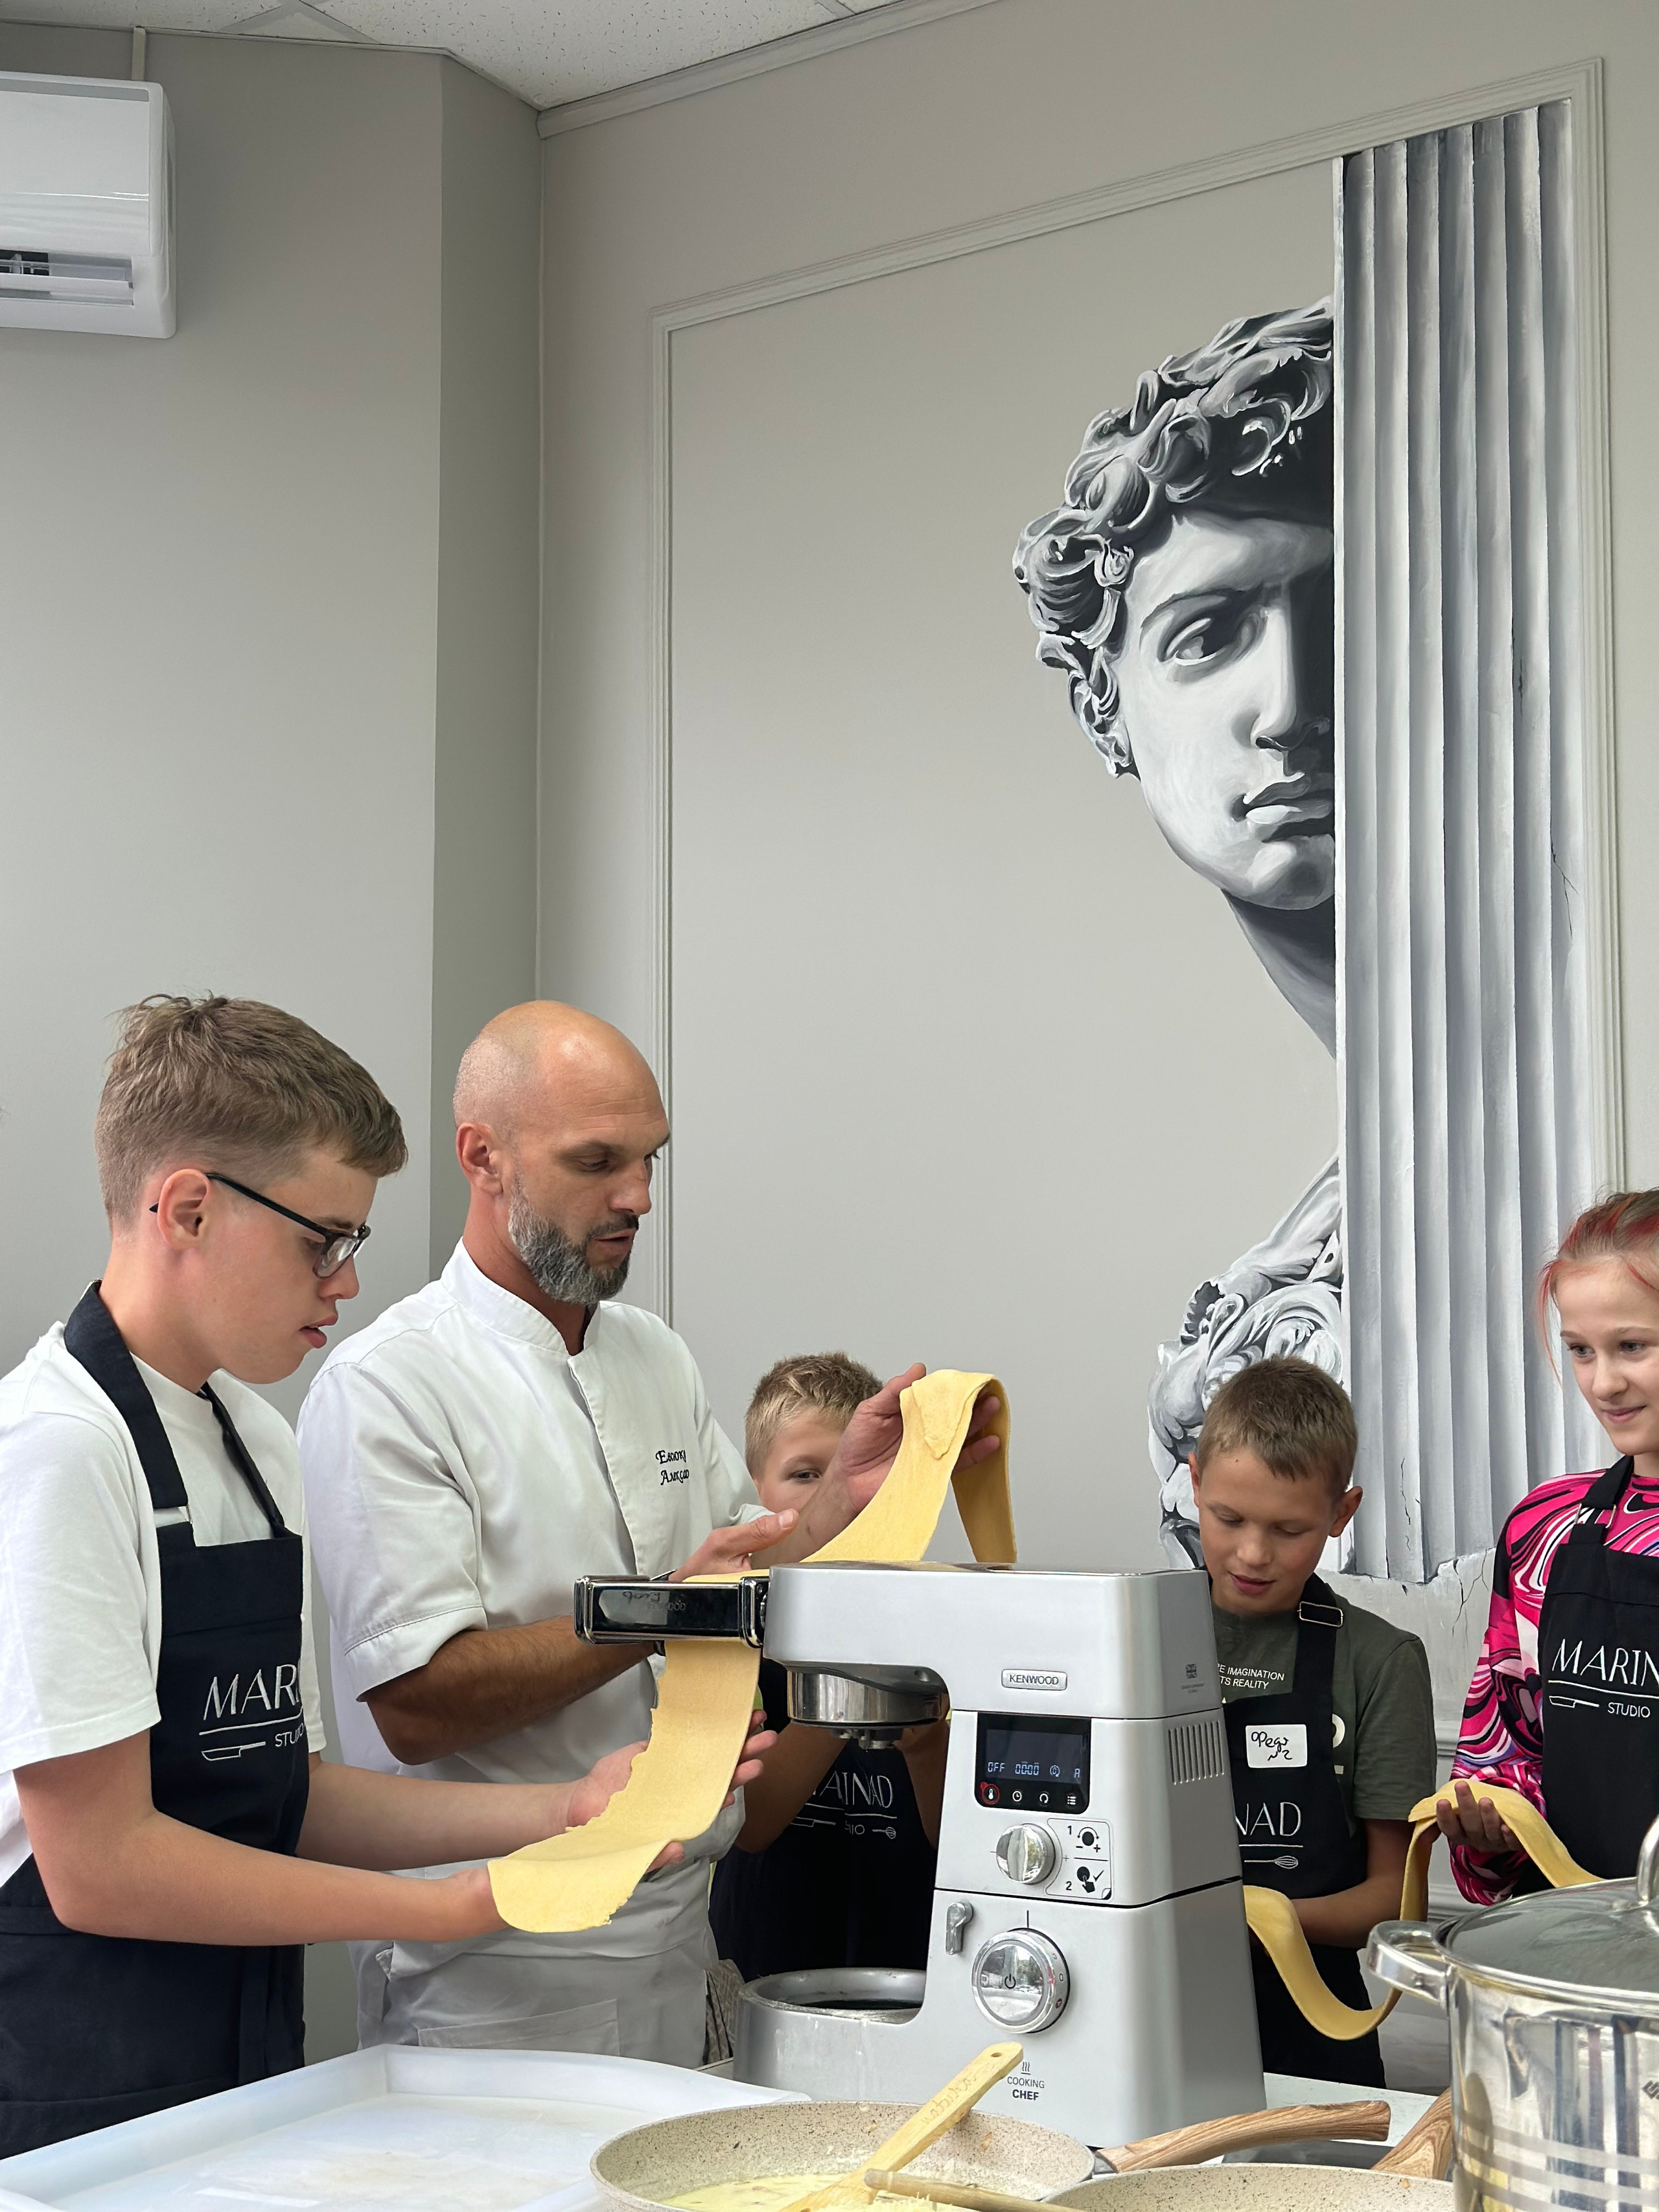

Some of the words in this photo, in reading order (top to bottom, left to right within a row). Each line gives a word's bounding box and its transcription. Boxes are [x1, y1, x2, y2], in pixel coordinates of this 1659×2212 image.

[1009, 1674, 1059, 1685] KENWOOD
[1227, 1667, 1284, 1681] IMAGINATION
[1233, 1679, 1269, 1690] REALITY
[1607, 1702, 1651, 1718] STUDIO
[988, 1762, 1005, 1773] OFF
[1067, 1825, 1073, 1835] 1
[1065, 1881, 1073, 1891] 2
[1007, 2076, 1045, 2089] COOKING
[1012, 2089, 1039, 2101] CHEF
